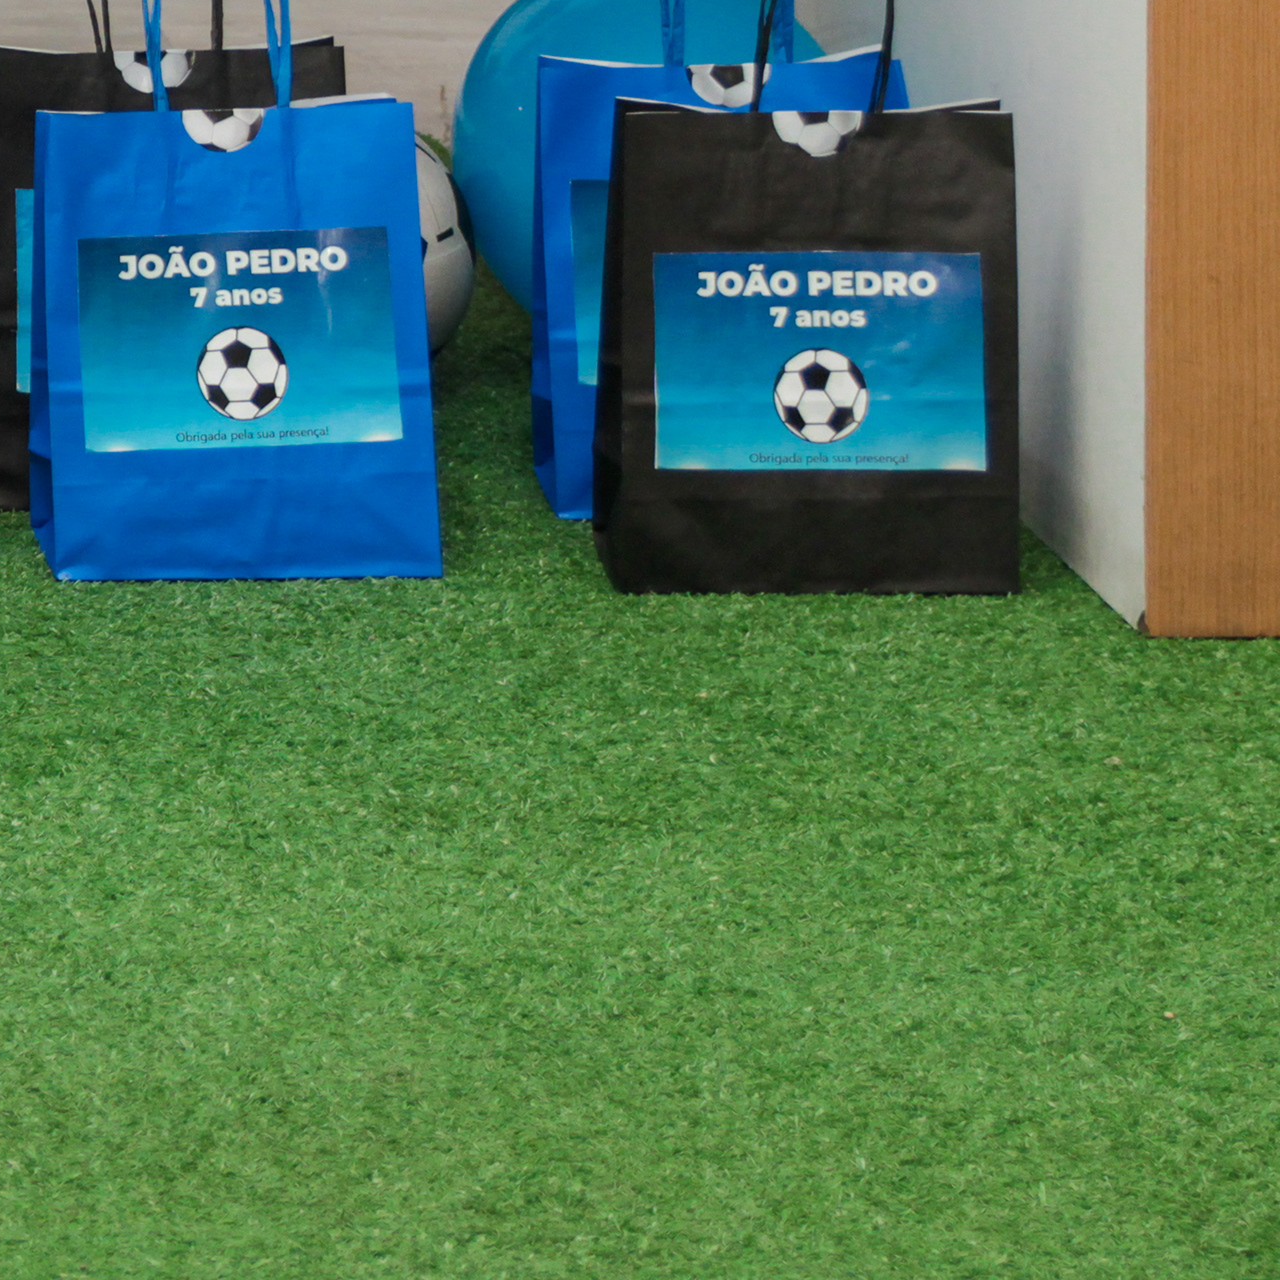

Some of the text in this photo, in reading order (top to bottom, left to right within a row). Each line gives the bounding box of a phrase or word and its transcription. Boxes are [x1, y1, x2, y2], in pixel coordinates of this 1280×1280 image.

[119, 246, 348, 280] JOÃO PEDRO
[696, 264, 938, 297] JOÃO PEDRO
[190, 287, 283, 308] 7 anos
[770, 306, 866, 327] 7 anos
[176, 427, 329, 443] Obrigada pela sua presença!
[749, 452, 802, 465] Obrigada
[806, 452, 828, 465] pela
[856, 454, 909, 465] presença!
